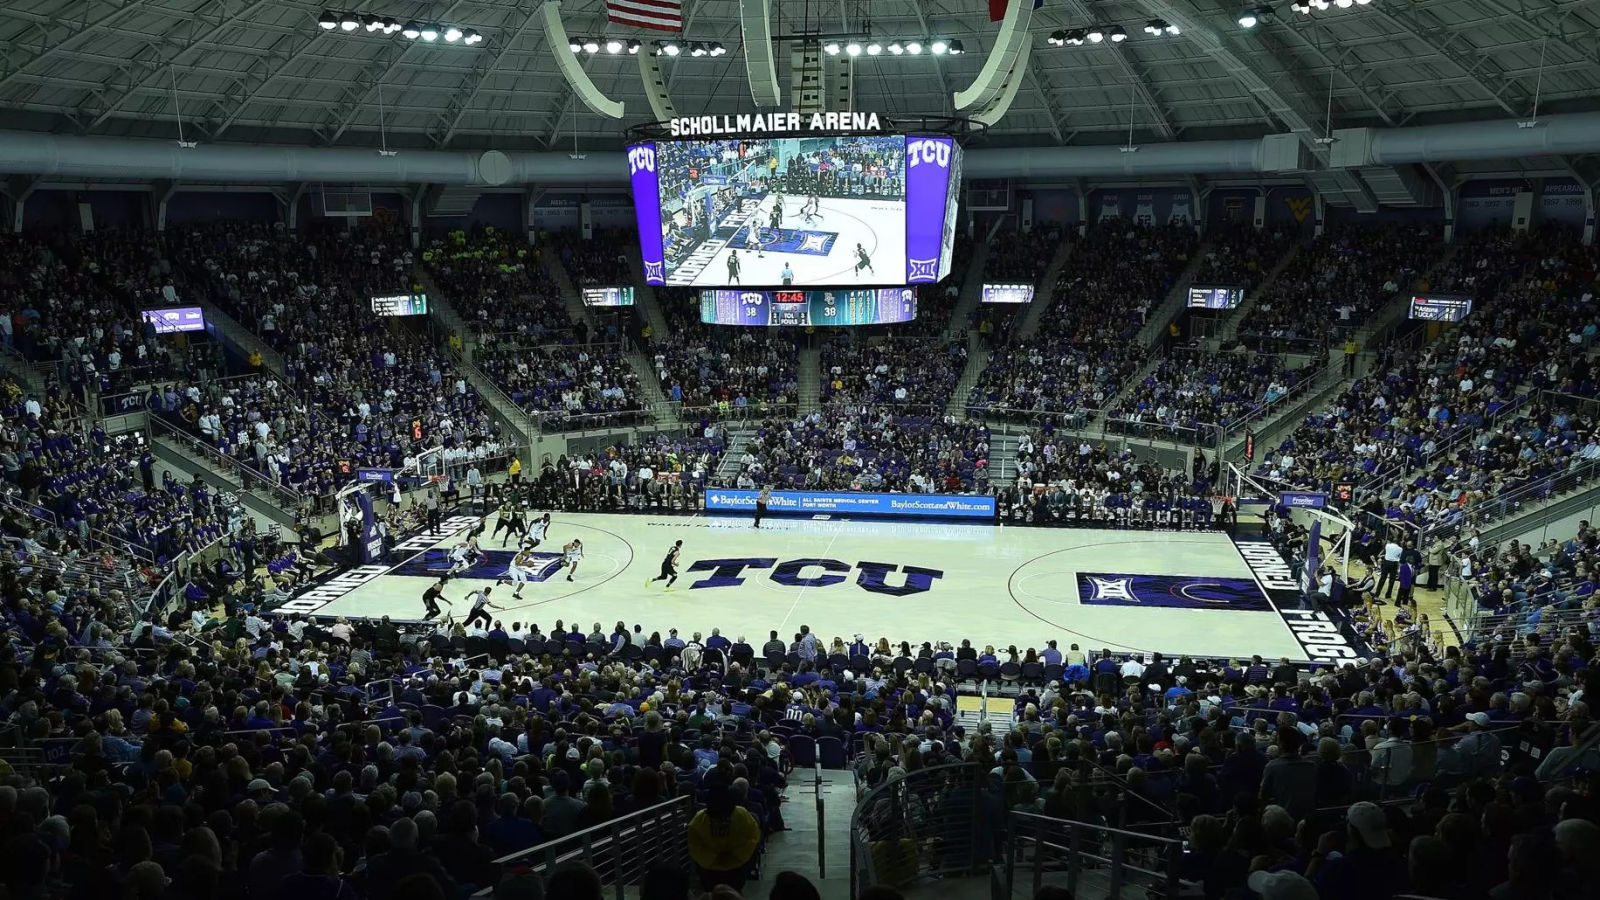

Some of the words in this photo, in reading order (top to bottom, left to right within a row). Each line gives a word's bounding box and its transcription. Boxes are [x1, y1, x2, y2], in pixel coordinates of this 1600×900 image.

[670, 114, 800, 136] SCHOLLMAIER
[809, 112, 881, 130] ARENA
[907, 140, 951, 168] TCU
[628, 147, 655, 176] TCU
[740, 292, 763, 306] TCU
[776, 292, 804, 302] 12:45
[745, 307, 757, 317] 38
[824, 306, 837, 317] 38
[891, 500, 990, 511] BaylorScottandWhite.com
[687, 557, 944, 597] TCU
